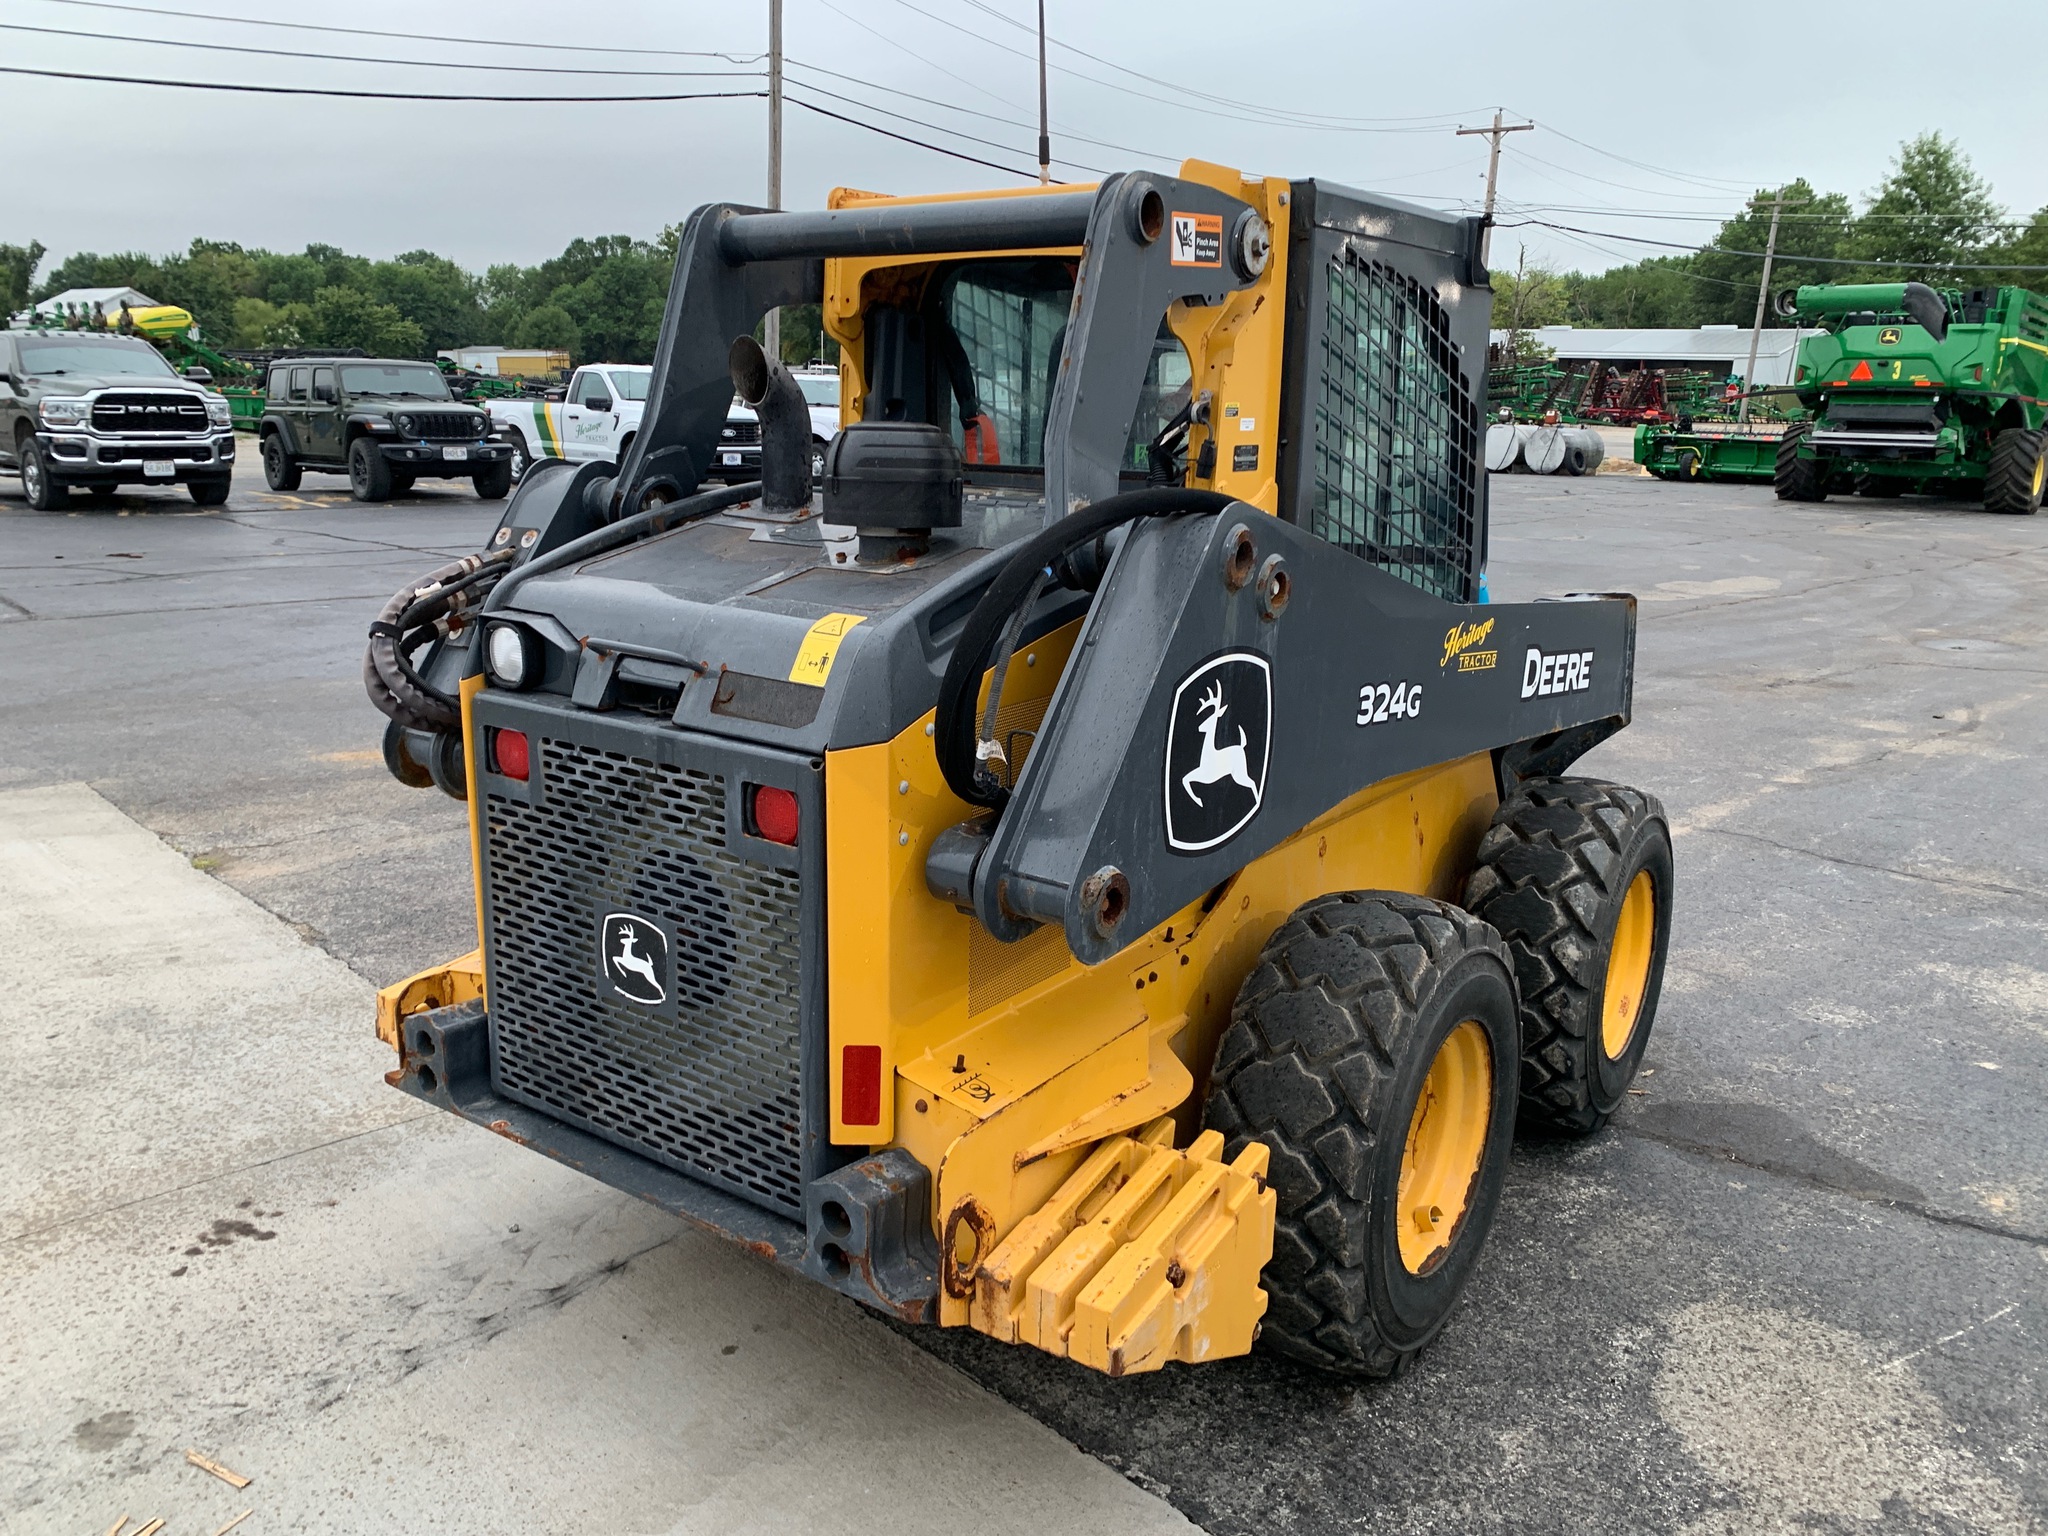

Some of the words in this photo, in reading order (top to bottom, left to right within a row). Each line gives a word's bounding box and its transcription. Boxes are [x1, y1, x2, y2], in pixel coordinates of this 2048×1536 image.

[1196, 237, 1208, 247] Pinch
[1209, 238, 1219, 247] Area
[1196, 248, 1205, 257] Keep
[1206, 249, 1216, 258] Away
[1892, 361, 1902, 380] 3
[127, 405, 177, 414] RAM
[576, 421, 602, 438] Heritage
[586, 434, 609, 442] TRACTOR
[1440, 617, 1495, 668] Heritage
[1459, 653, 1497, 669] TRACTOR
[1521, 648, 1594, 699] DEERE
[1356, 681, 1423, 726] 324G
